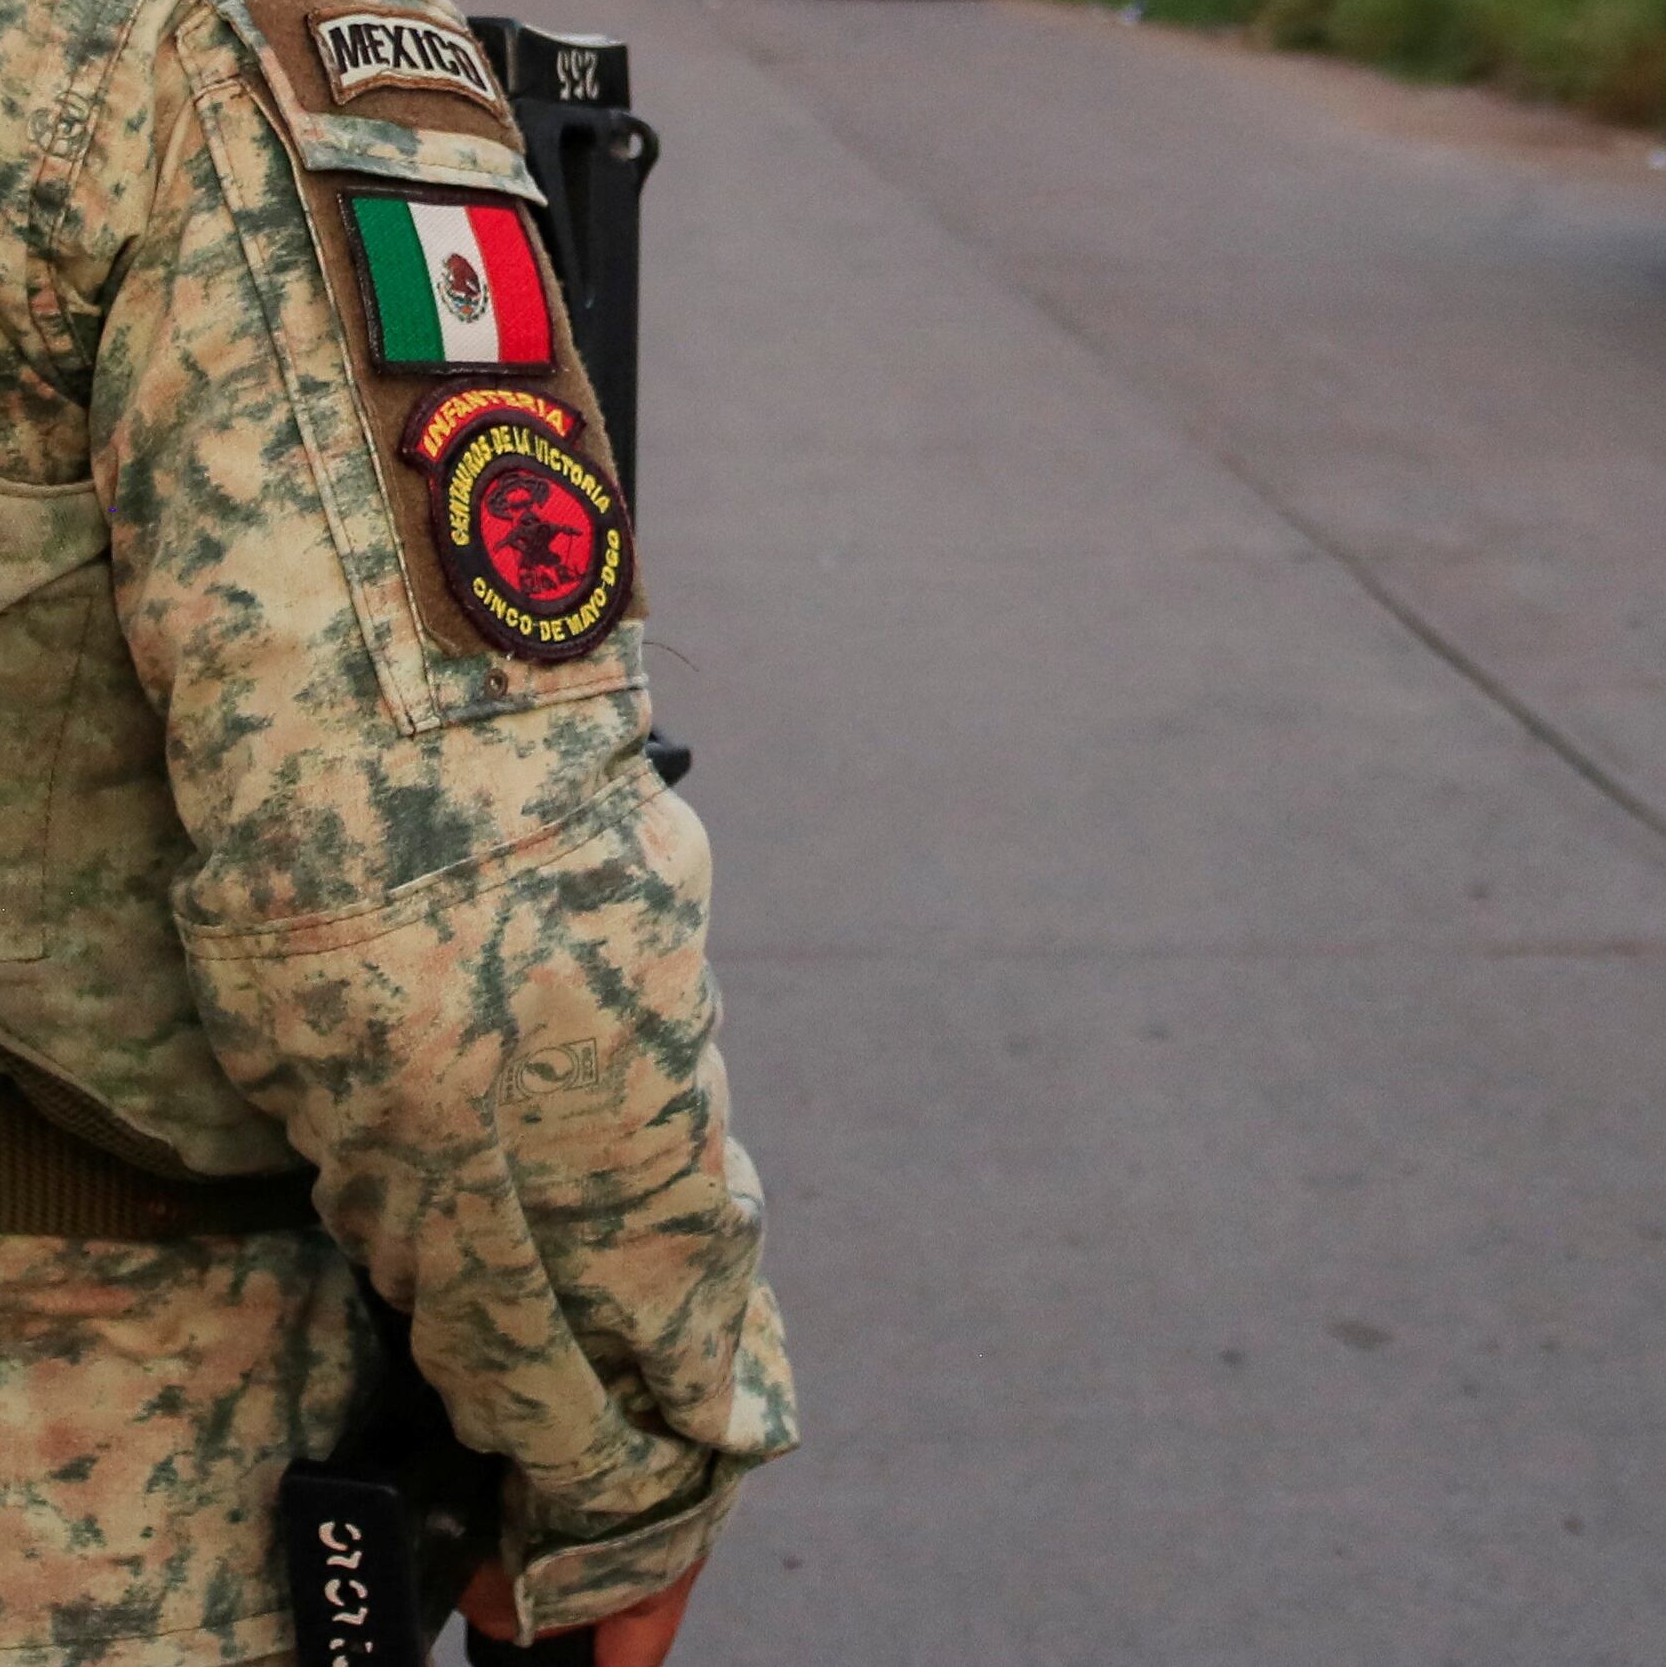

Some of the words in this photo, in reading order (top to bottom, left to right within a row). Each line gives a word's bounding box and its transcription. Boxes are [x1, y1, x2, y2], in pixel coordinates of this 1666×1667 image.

[328, 23, 488, 92] MEXICO
[423, 389, 566, 458] INFANTERIA
[448, 434, 492, 546] CENTAUROS
[490, 425, 514, 455] DE
[513, 425, 531, 456] LA
[535, 434, 611, 514] VICTORIA
[473, 576, 532, 636] CINCO
[539, 620, 565, 642] DE
